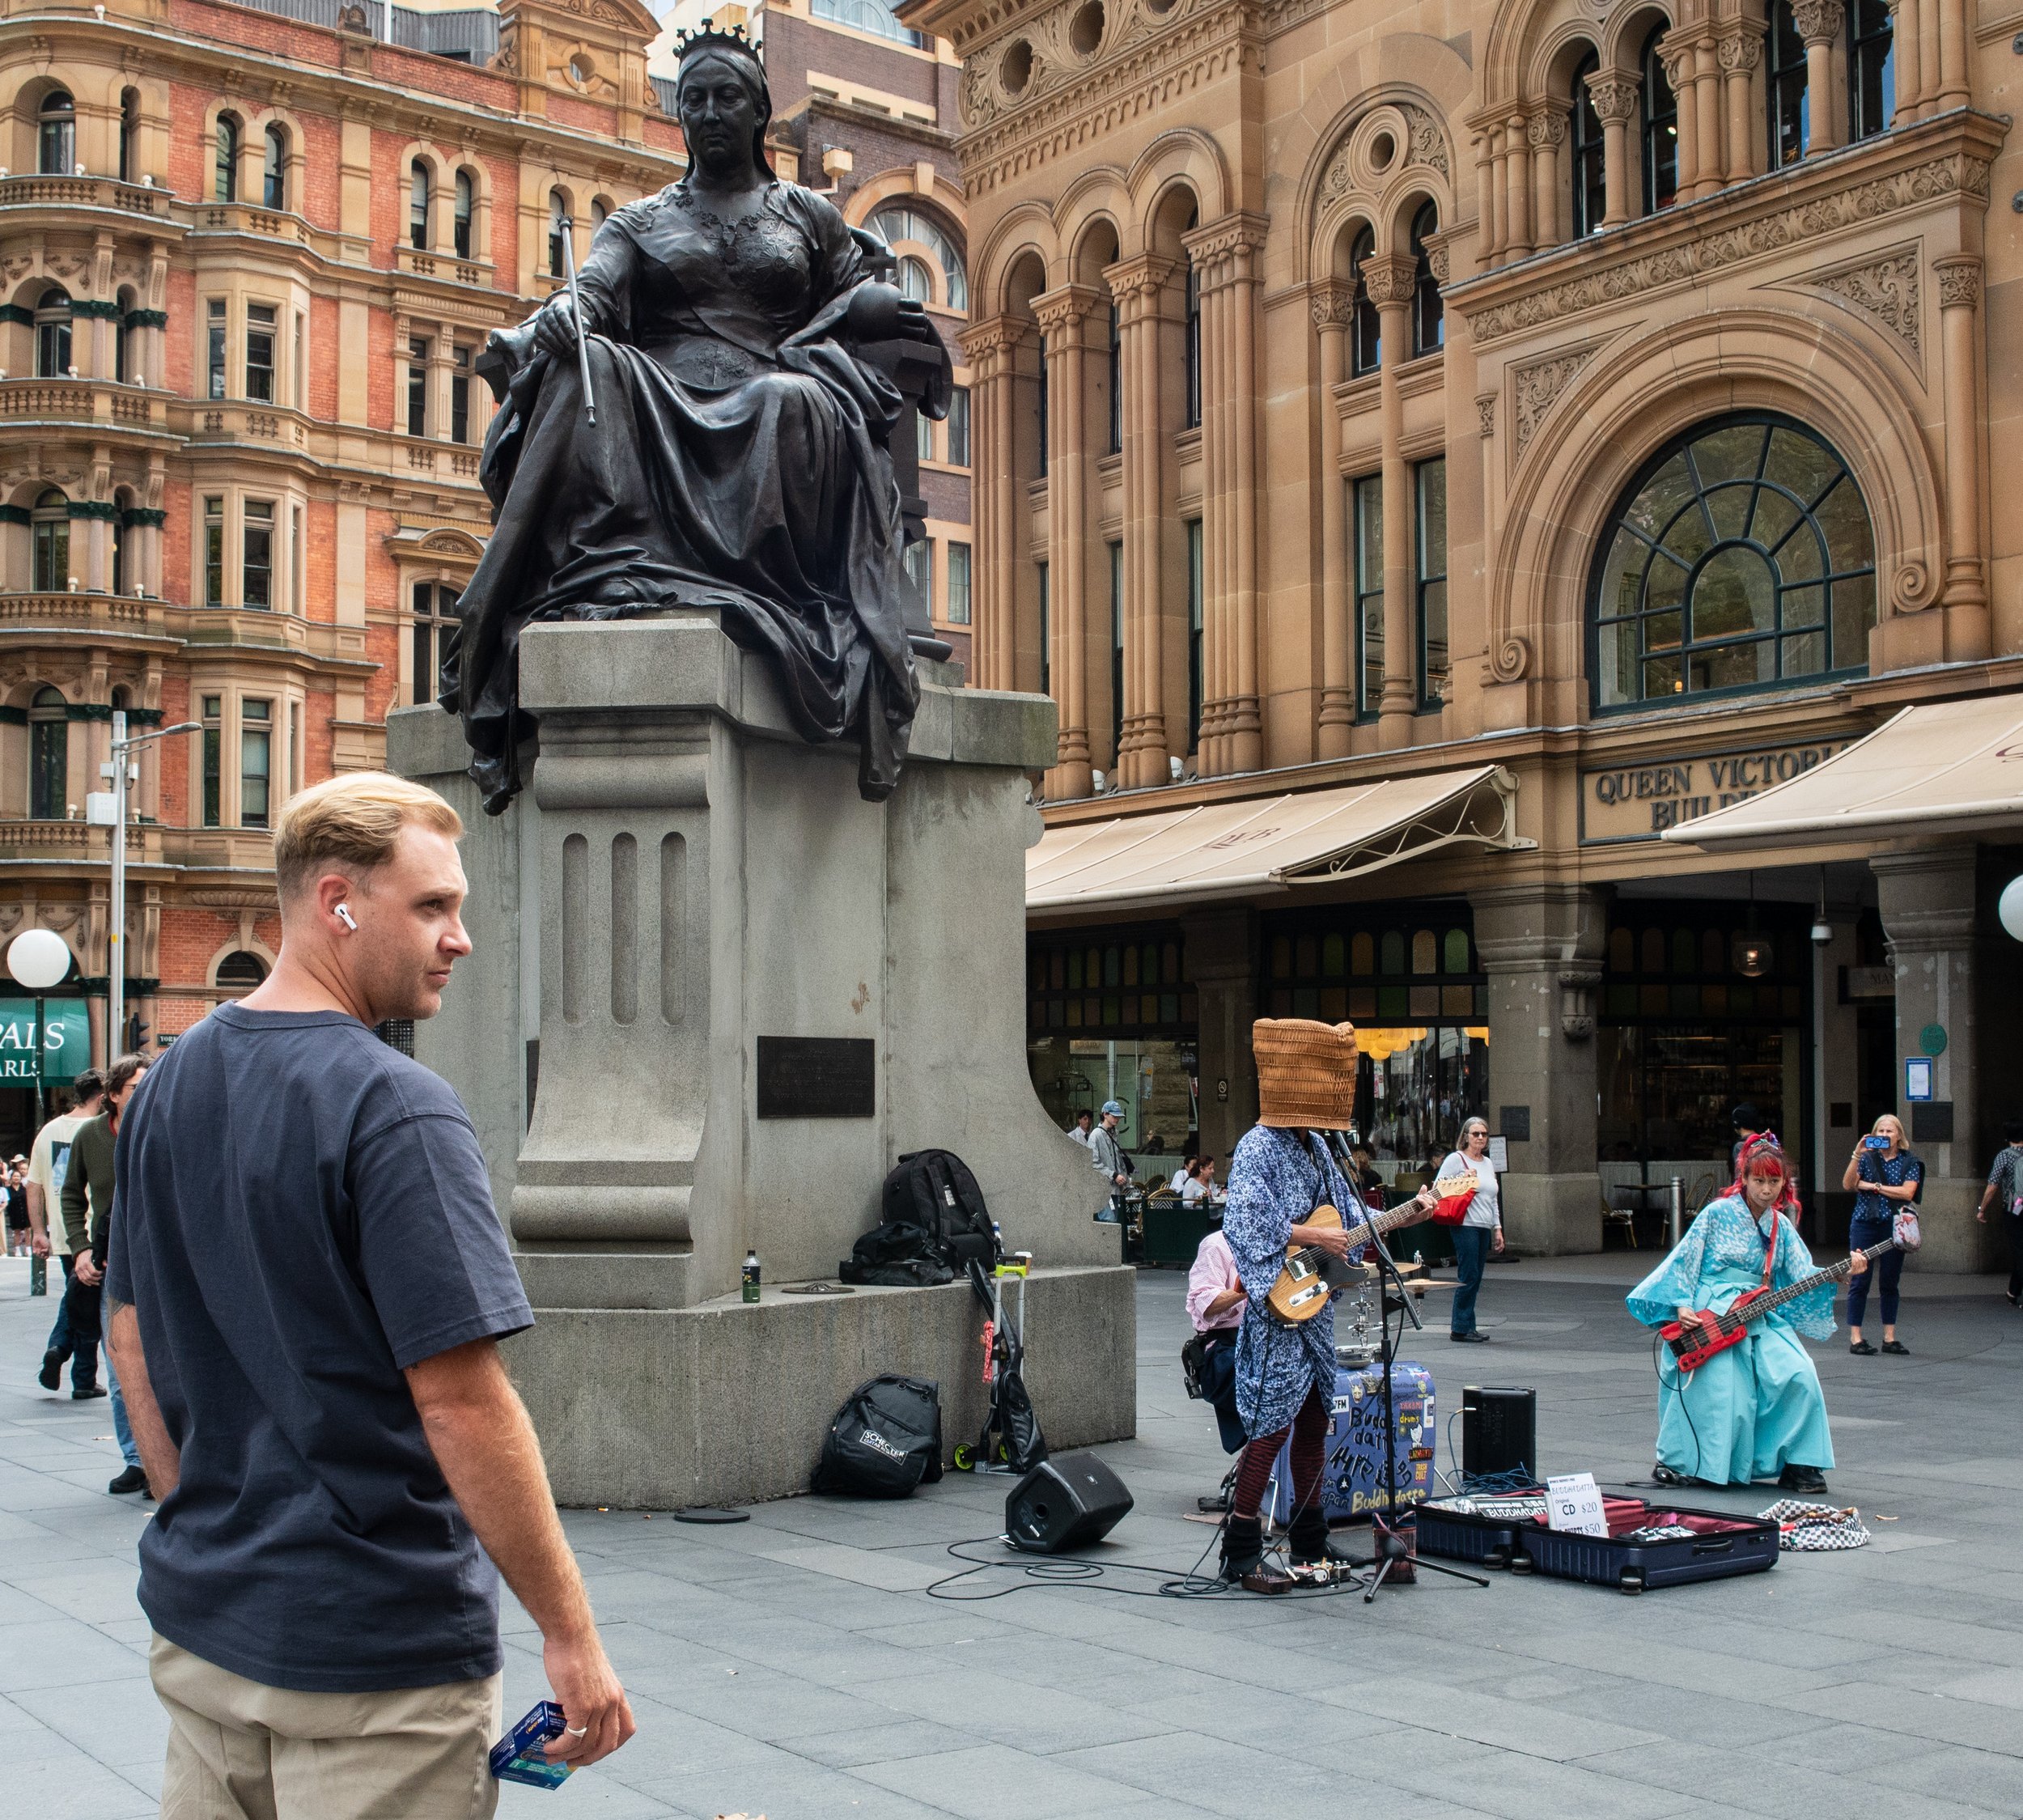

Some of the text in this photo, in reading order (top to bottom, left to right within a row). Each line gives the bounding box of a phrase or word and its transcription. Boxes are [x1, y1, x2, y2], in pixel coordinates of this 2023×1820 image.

[1596, 742, 1849, 805] QUEEN VICTOR
[1650, 789, 1770, 831] BUIL
[1399, 1412, 1419, 1424] drums
[865, 1432, 905, 1457] SCHECTER
[1353, 1427, 1397, 1458] datt
[1551, 1483, 1594, 1495] BUDDHADATTA
[1351, 1487, 1427, 1515] Buddhdatta
[1562, 1501, 1597, 1516] CD $20
[1486, 1507, 1548, 1518] BUDDHADATT
[1584, 1522, 1601, 1535] $50
